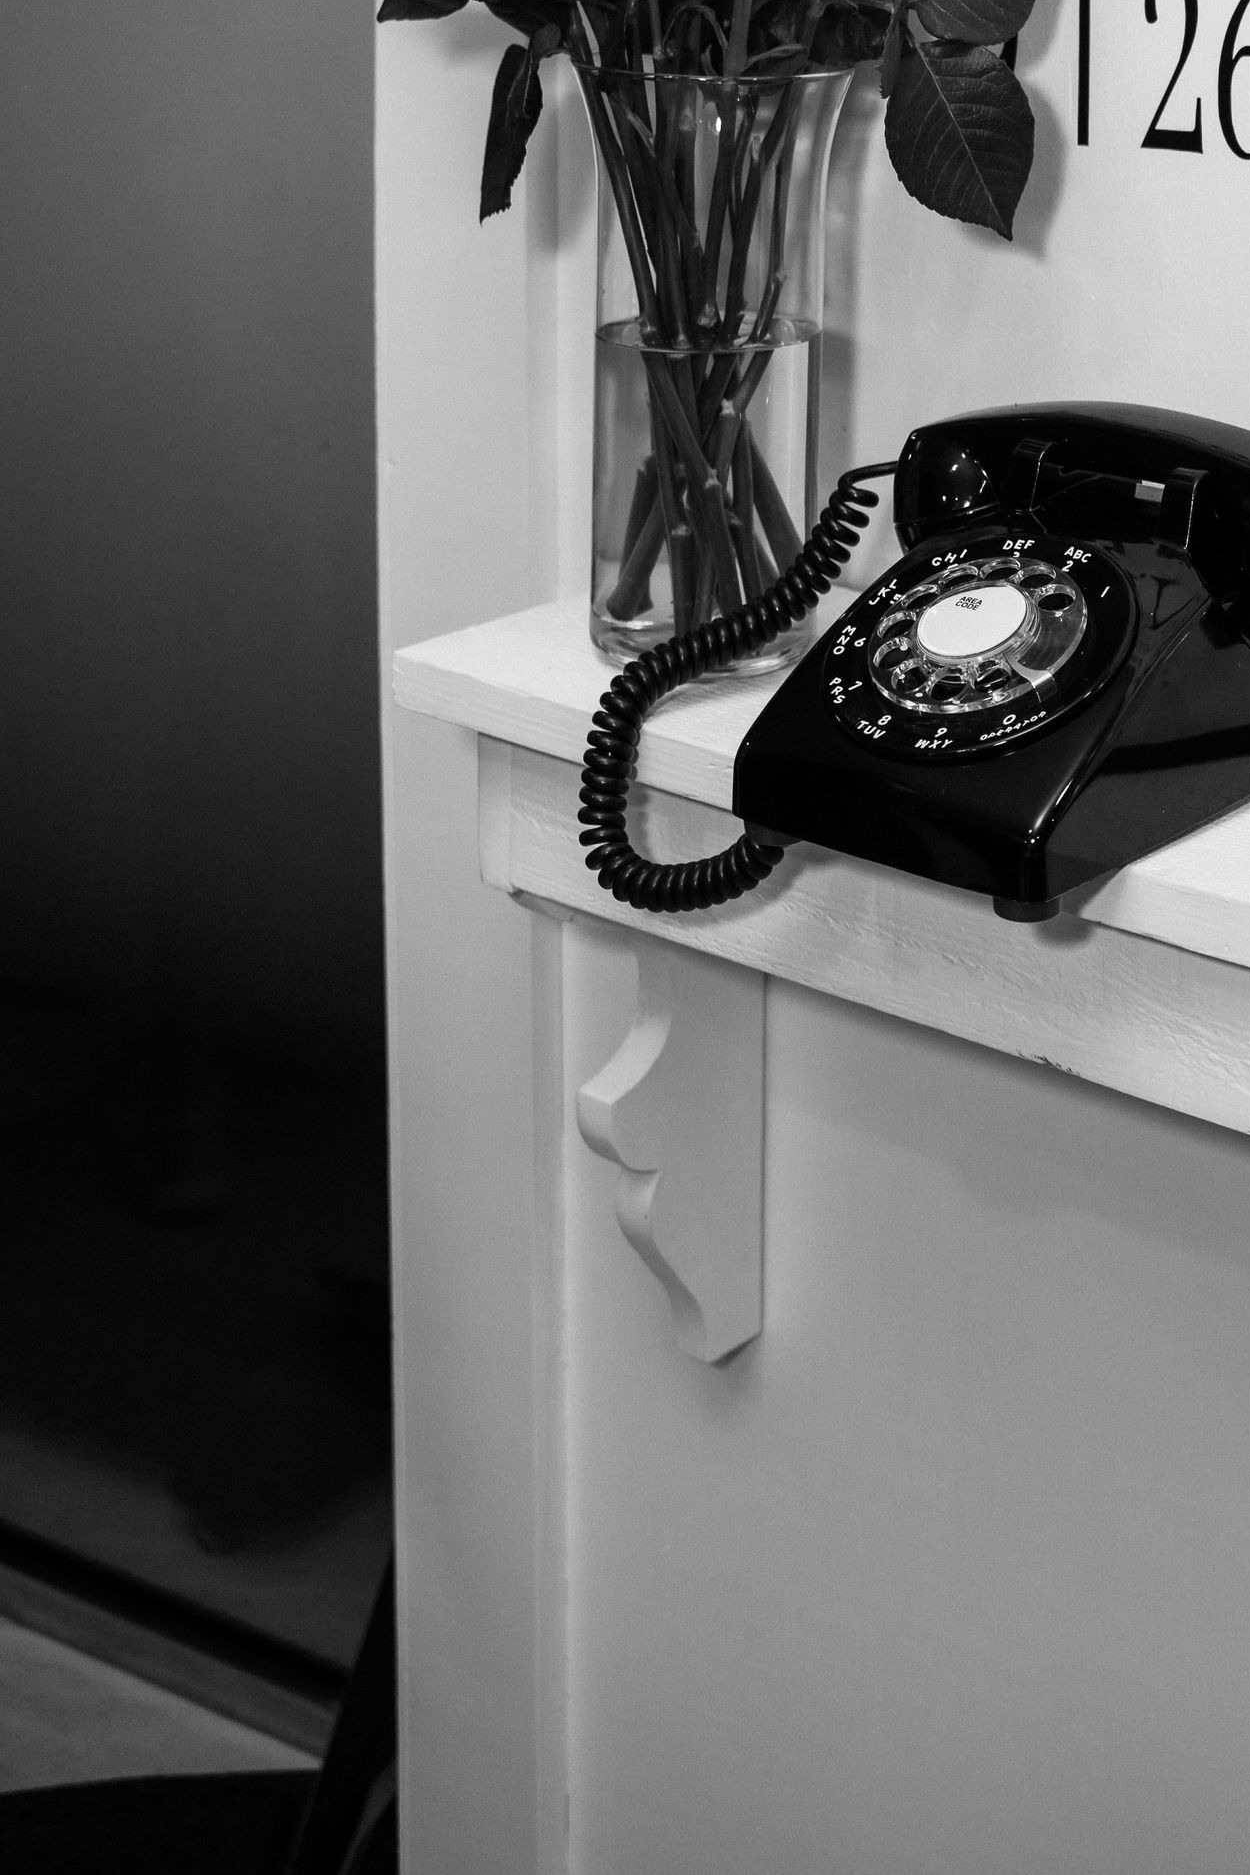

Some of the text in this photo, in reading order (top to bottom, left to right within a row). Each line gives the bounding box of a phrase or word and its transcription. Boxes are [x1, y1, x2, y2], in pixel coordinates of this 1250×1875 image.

[1002, 539, 1035, 550] DEF
[932, 549, 967, 566] GHI
[1064, 546, 1092, 563] ABC
[1062, 560, 1073, 572] 2
[955, 601, 980, 611] CODE
[960, 596, 983, 606] AREA
[854, 637, 866, 647] 6
[878, 715, 892, 725] 8
[857, 721, 886, 739] TUV
[980, 711, 1046, 741] OPERATOR
[934, 727, 948, 737] 9
[915, 739, 953, 749] WXY
